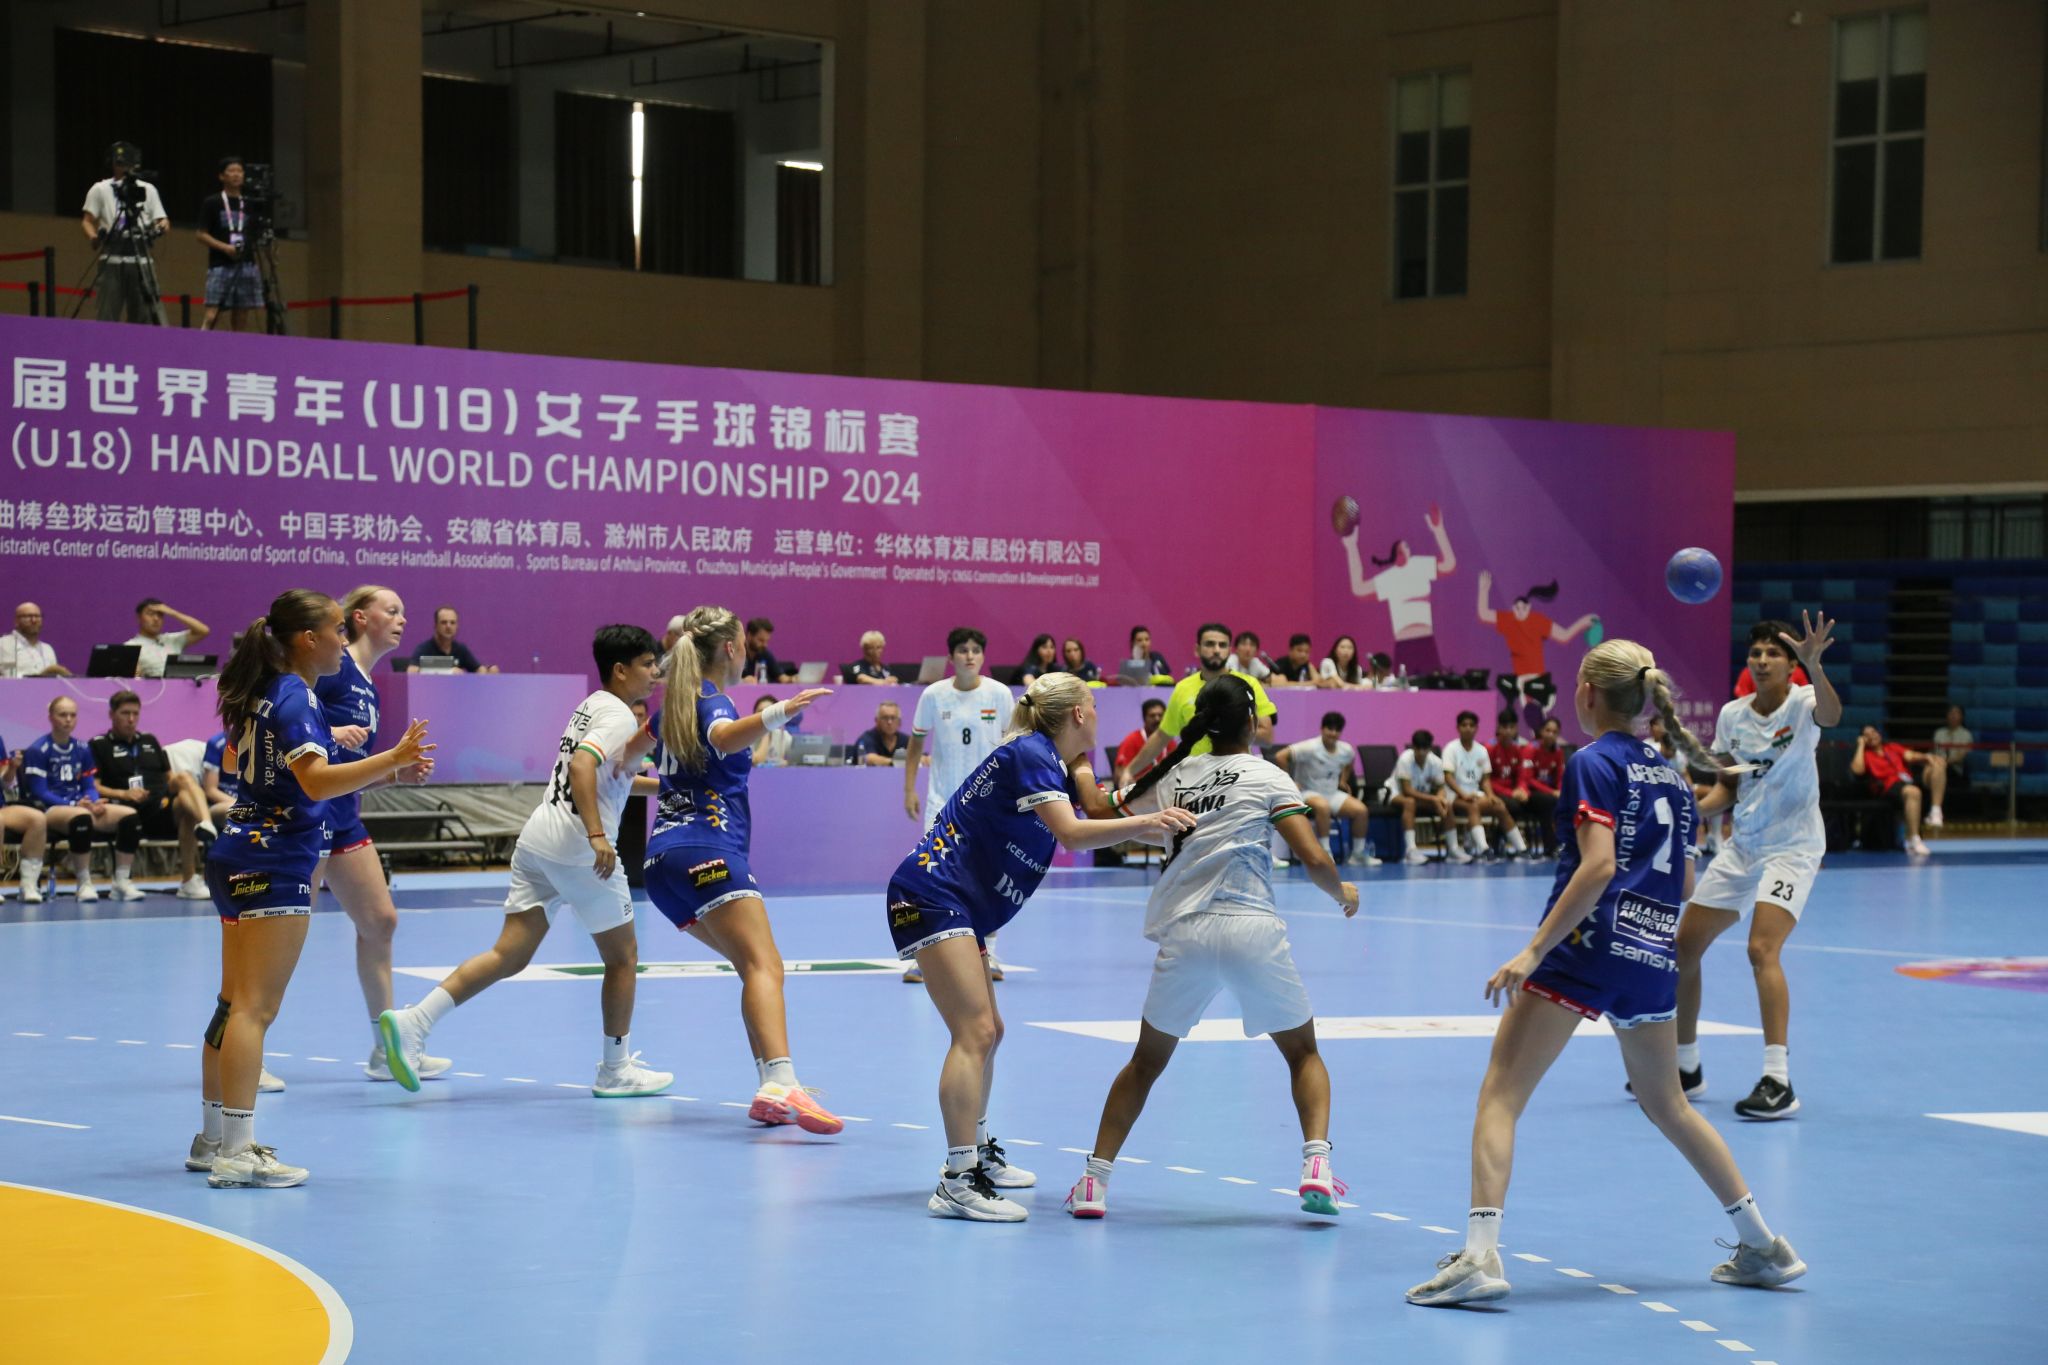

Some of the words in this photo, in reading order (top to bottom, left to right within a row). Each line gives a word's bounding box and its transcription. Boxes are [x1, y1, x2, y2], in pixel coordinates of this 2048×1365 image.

[11, 422, 132, 475] (U18)
[150, 434, 378, 482] HANDBALL
[391, 446, 533, 488] WORLD
[545, 453, 829, 501] CHAMPIONSHIP
[842, 468, 921, 505] 2024
[53, 538, 94, 557] Center
[97, 539, 110, 556] of
[112, 540, 159, 559] General
[162, 543, 248, 561] Administration
[251, 545, 263, 562] of
[265, 546, 296, 566] Sport
[299, 547, 311, 562] of
[356, 549, 399, 567] Chinese
[401, 550, 451, 568] Handball
[527, 553, 559, 573] Sports
[562, 555, 598, 572] Bureau
[601, 556, 612, 571] of
[613, 556, 643, 573] Anhui
[696, 559, 738, 576] Chuzhou
[741, 560, 787, 579] Municipal
[831, 563, 887, 580] Government
[893, 564, 935, 583] Operated
[962, 727, 971, 745] 8
[960, 757, 1000, 806] Arnarlax
[1616, 788, 1641, 873] Arnarlax
[1770, 880, 1794, 901] 23
